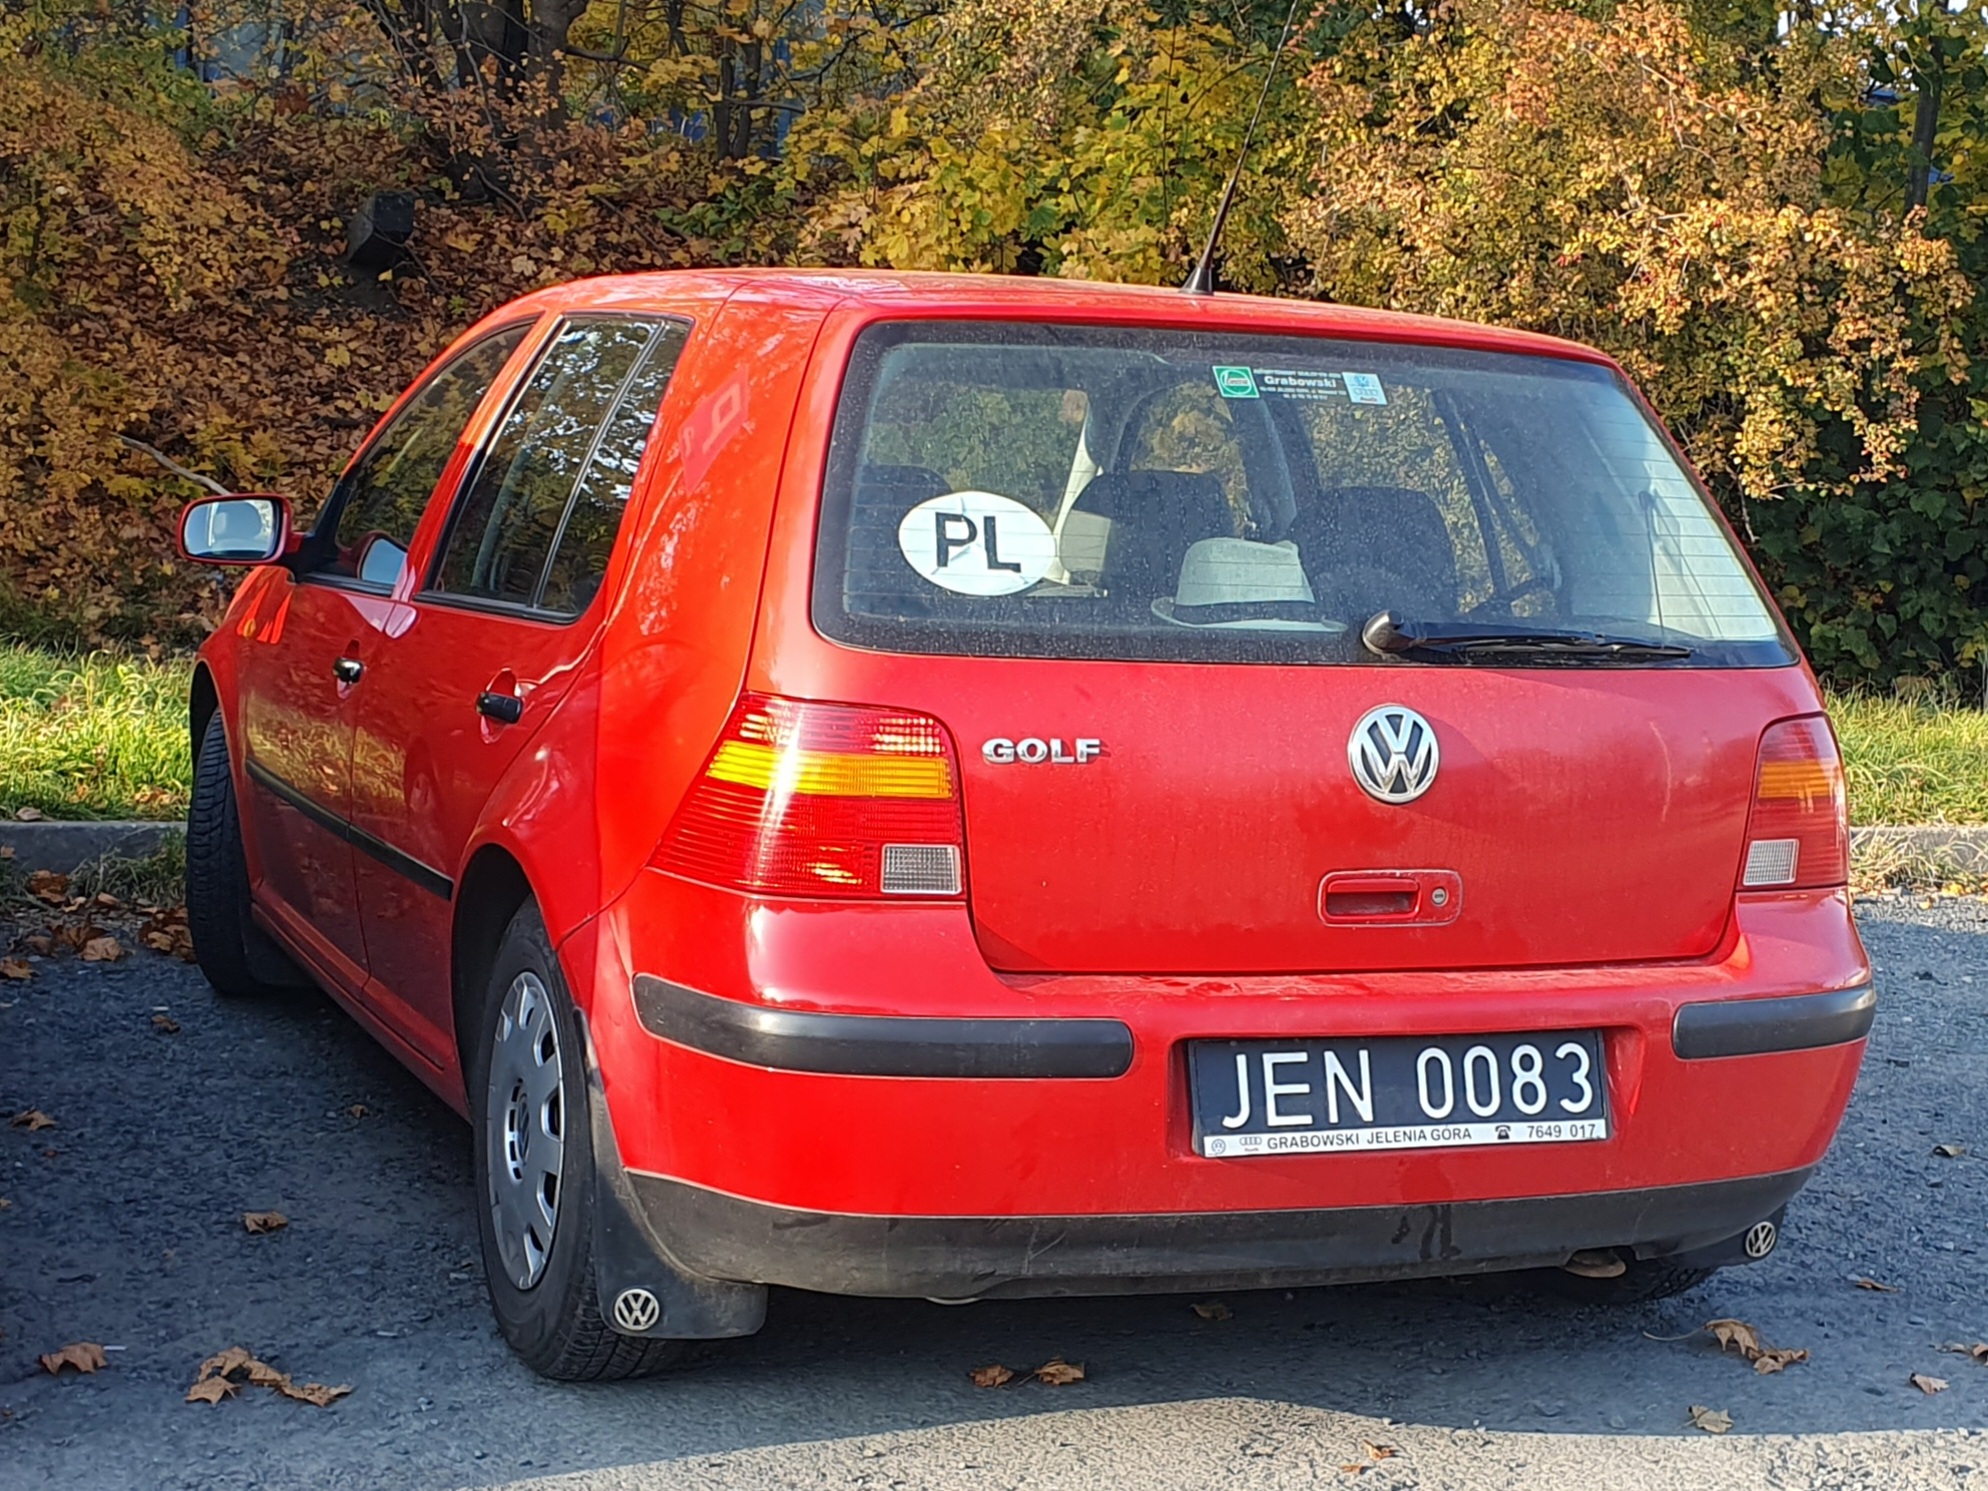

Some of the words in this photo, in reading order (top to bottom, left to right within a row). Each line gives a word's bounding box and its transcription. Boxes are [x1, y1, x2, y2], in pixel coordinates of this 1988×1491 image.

[1264, 375, 1338, 388] Grabowski
[936, 512, 1021, 573] PL
[981, 738, 1101, 764] GOLF
[1222, 1049, 1374, 1129] JEN
[1416, 1042, 1594, 1119] 0083
[1267, 1134, 1360, 1150] GRABOWSKI
[1366, 1128, 1428, 1144] JELENIA
[1430, 1125, 1473, 1141] GÓRA
[1527, 1124, 1562, 1139] 7649
